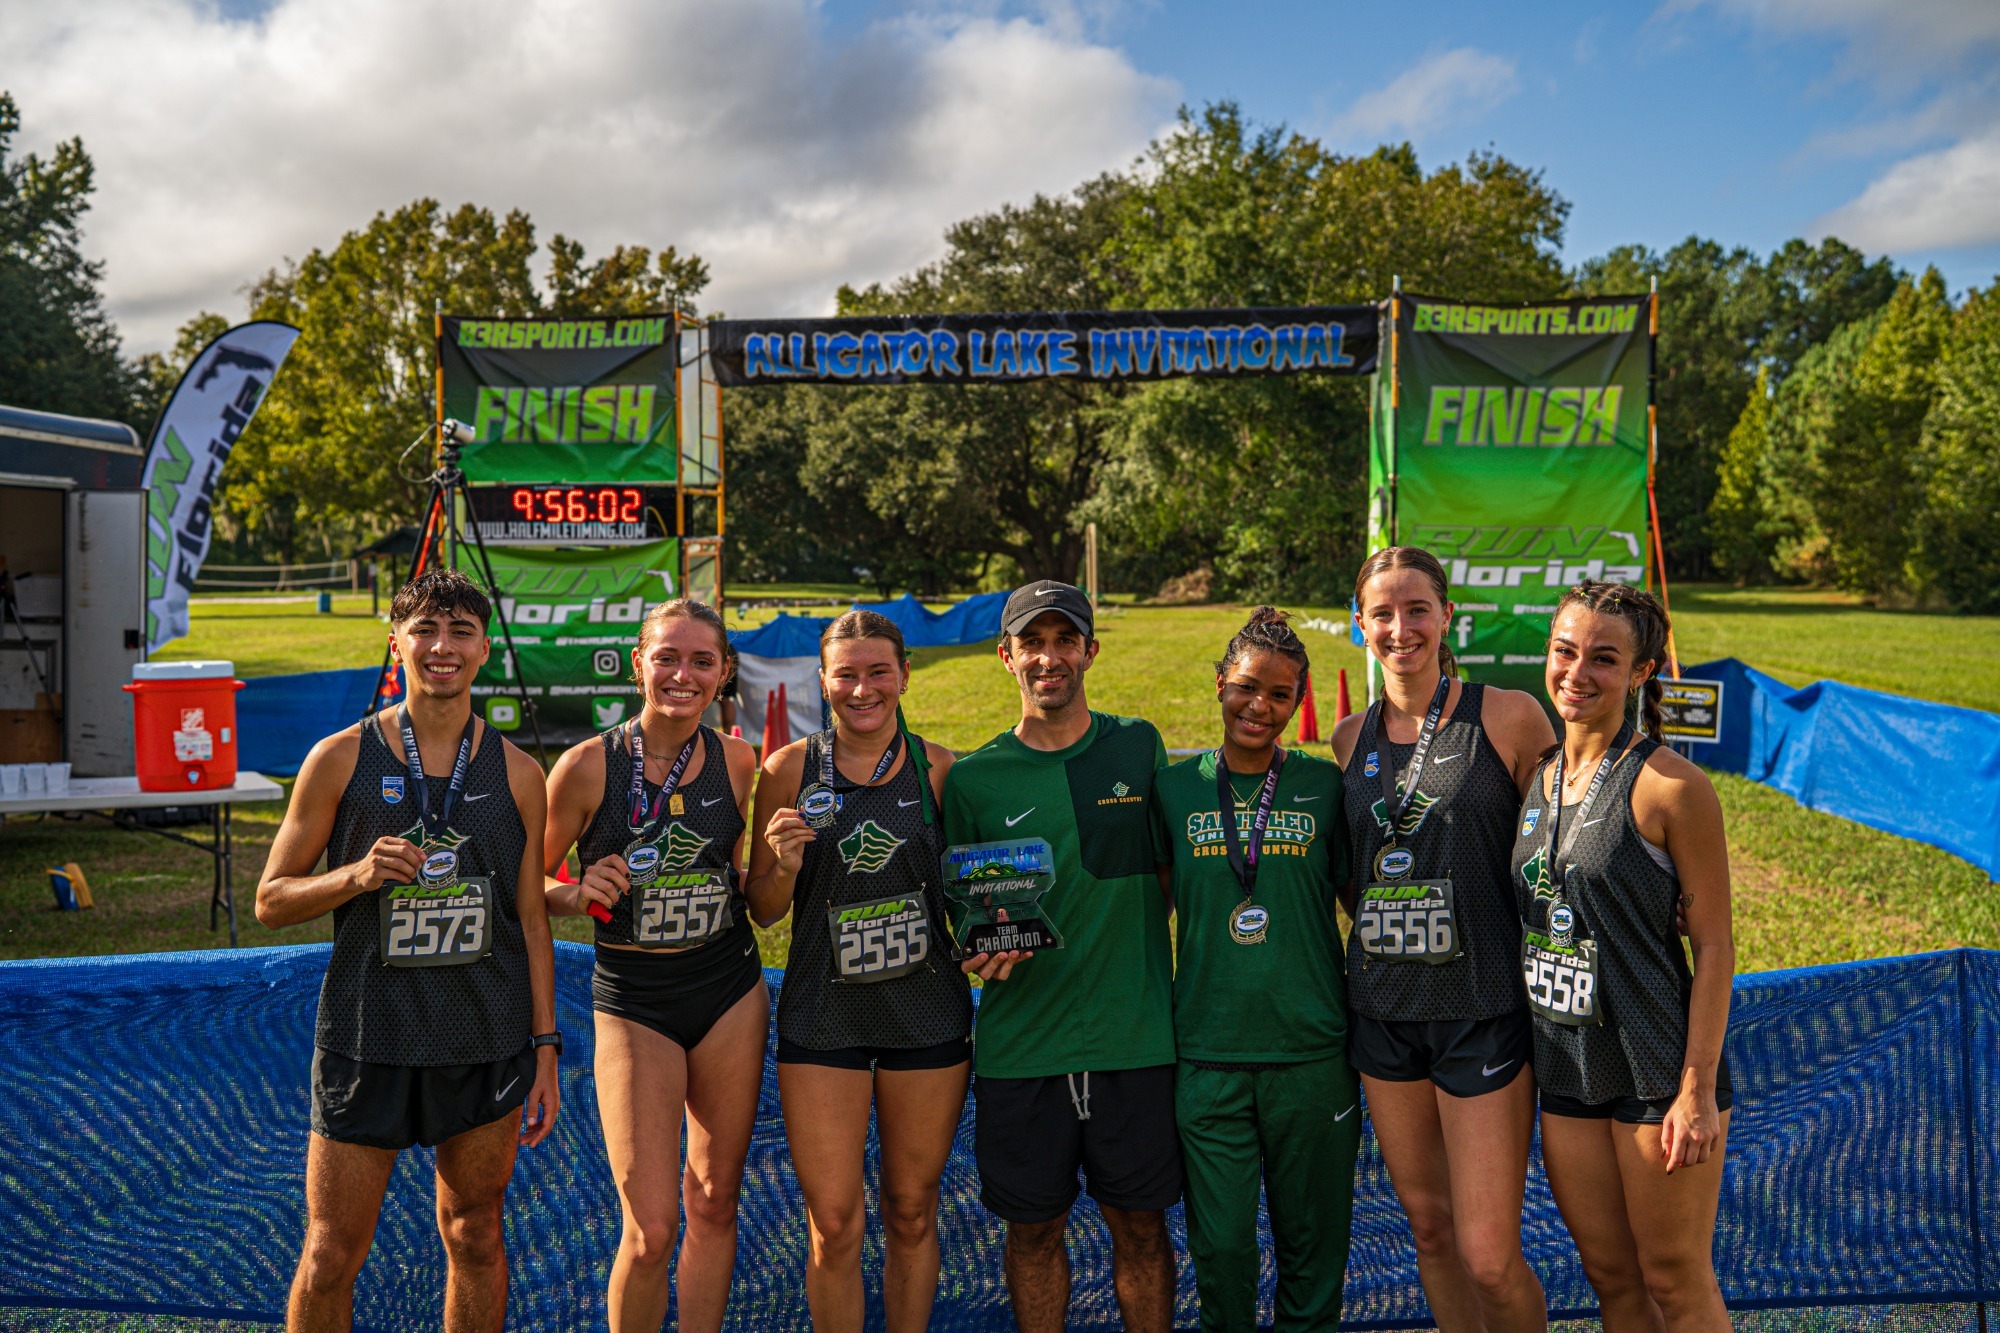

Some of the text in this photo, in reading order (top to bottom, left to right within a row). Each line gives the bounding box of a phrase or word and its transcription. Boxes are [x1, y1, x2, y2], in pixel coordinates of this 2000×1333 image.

[457, 318, 667, 349] B3RSPORTS.COM
[1412, 303, 1639, 334] B3RSPORTS.COM
[744, 322, 1354, 378] ALLIGATOR LAKE INVITATIONAL
[473, 385, 657, 444] FINISH
[1422, 385, 1623, 447] FINISH
[513, 488, 642, 532] 9:56:02
[1409, 525, 1608, 558] RUN
[1440, 559, 1645, 586] lorida
[490, 597, 660, 625] lorid
[401, 726, 425, 780] FINISHER
[1410, 707, 1441, 774] 3RD PLACE
[450, 737, 472, 791] FINISHER
[632, 761, 644, 796] PLACE
[662, 774, 679, 795] 6TH
[673, 743, 694, 775] PLACE
[1254, 768, 1280, 831] 8TH PLACE
[1578, 757, 1613, 817] FINISHER
[1196, 830, 1304, 843] UNIESITY
[1265, 811, 1316, 836] LEO
[1016, 844, 1045, 856] LAKE
[1194, 845, 1228, 857] CROS
[392, 895, 485, 910] Florida
[643, 884, 726, 899] Florida
[969, 879, 1037, 896] INVITATIONAL
[1363, 885, 1431, 900] RUN
[639, 894, 729, 941] 2557
[836, 899, 908, 924] RUN
[1364, 898, 1445, 911] Florida
[387, 907, 486, 956] 2573
[841, 910, 922, 933] Florida
[996, 925, 1018, 936] TEAM
[1360, 909, 1452, 954] 2556
[839, 918, 928, 975] 2555
[976, 931, 1041, 953] CHAMPION
[1526, 944, 1590, 970] Florida
[1524, 956, 1595, 1016] 2558
